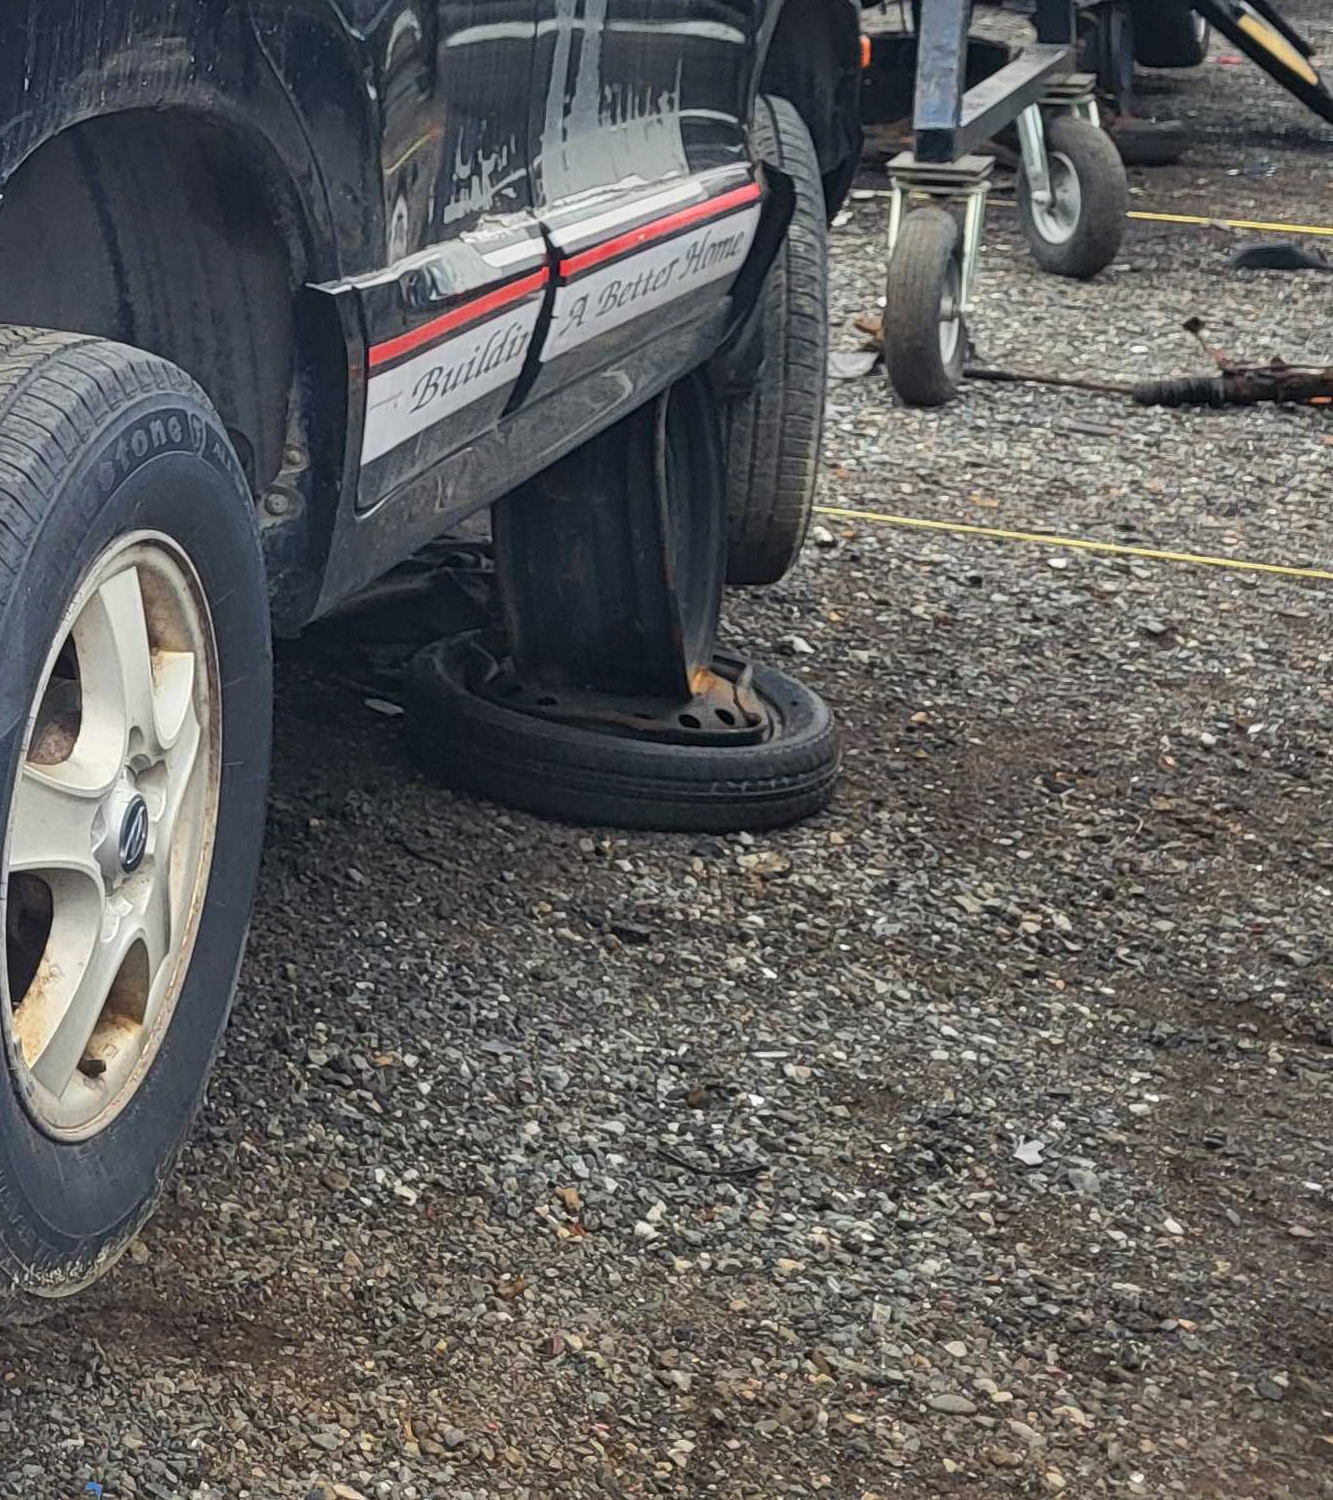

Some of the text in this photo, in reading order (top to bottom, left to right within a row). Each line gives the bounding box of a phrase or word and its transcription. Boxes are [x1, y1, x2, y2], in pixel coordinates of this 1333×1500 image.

[559, 296, 589, 337] A
[598, 256, 678, 315] Better
[678, 229, 746, 284] Home
